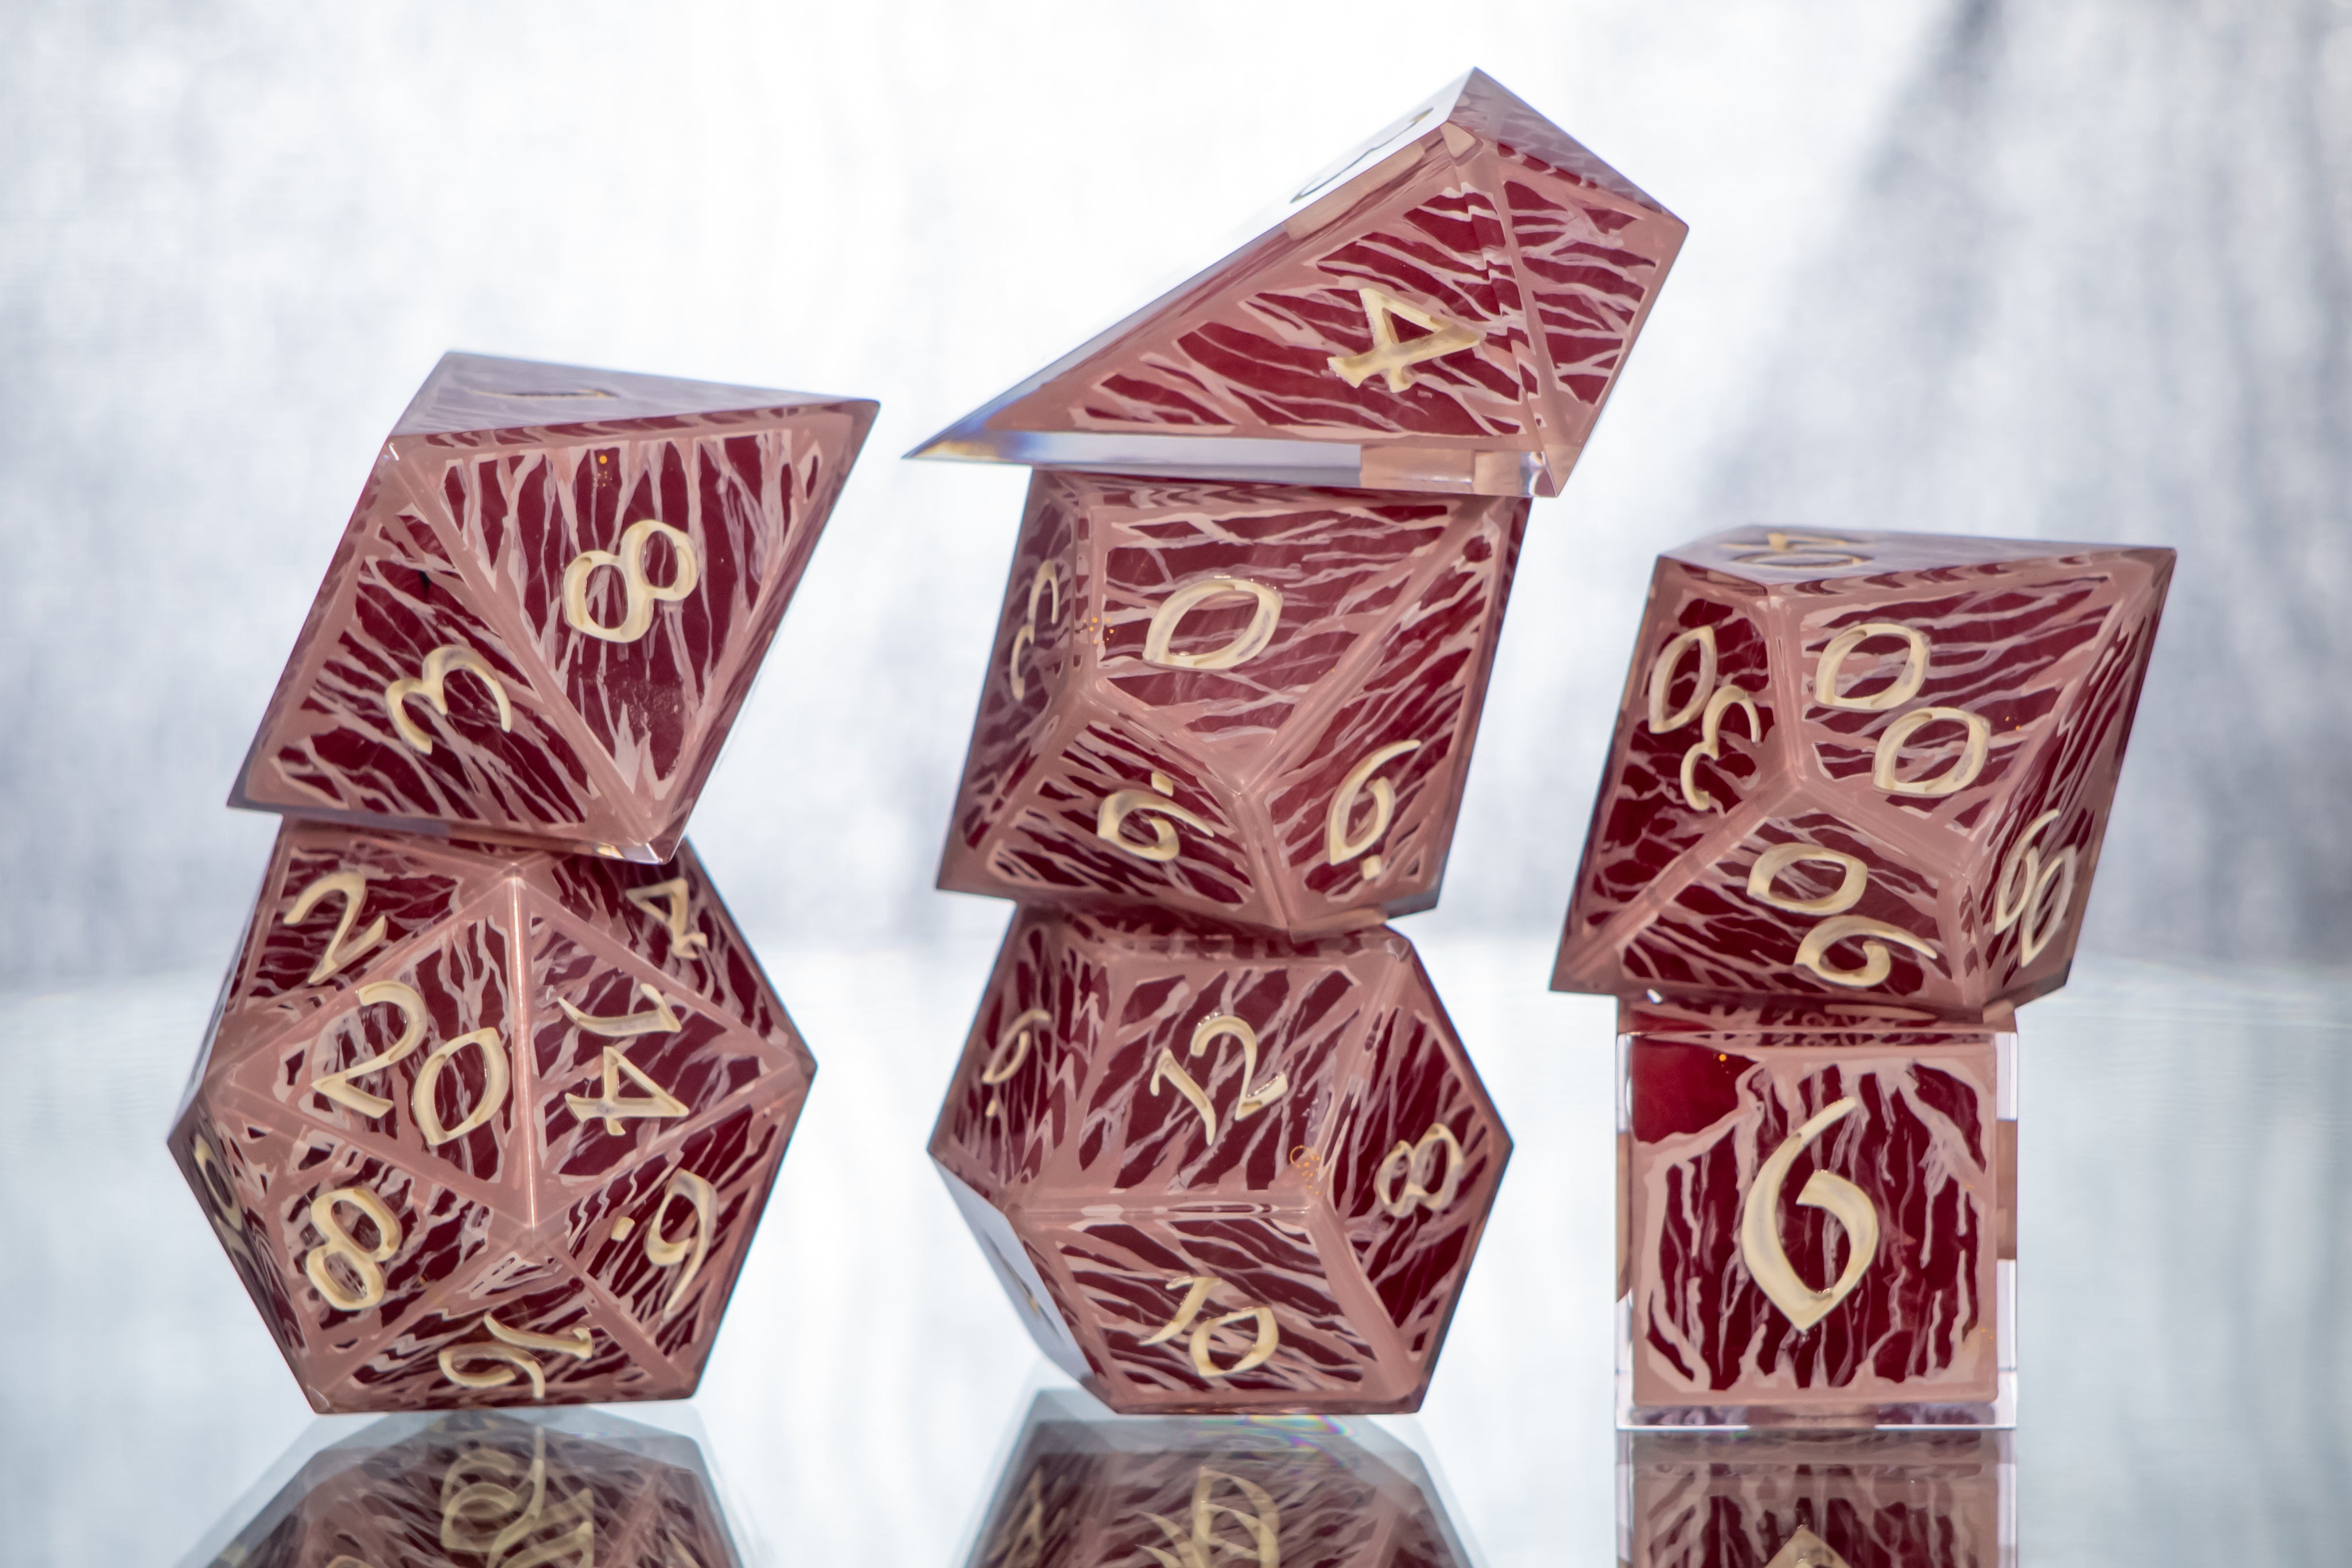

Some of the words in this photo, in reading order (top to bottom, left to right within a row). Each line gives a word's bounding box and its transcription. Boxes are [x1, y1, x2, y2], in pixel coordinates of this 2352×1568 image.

[1327, 288, 1487, 394] 4
[564, 519, 698, 642] 8
[1143, 577, 1284, 669] 0
[386, 645, 511, 754] 3
[1815, 622, 1991, 797] 00
[284, 872, 386, 984] 2
[626, 878, 707, 958] 4
[312, 981, 511, 1146] 20
[558, 983, 689, 1136] 14
[1150, 1014, 1288, 1146] 12
[1376, 1123, 1464, 1218] 8
[1741, 1096, 1879, 1333] 6
[305, 1187, 402, 1310] 8
[1139, 1276, 1279, 1377] 10
